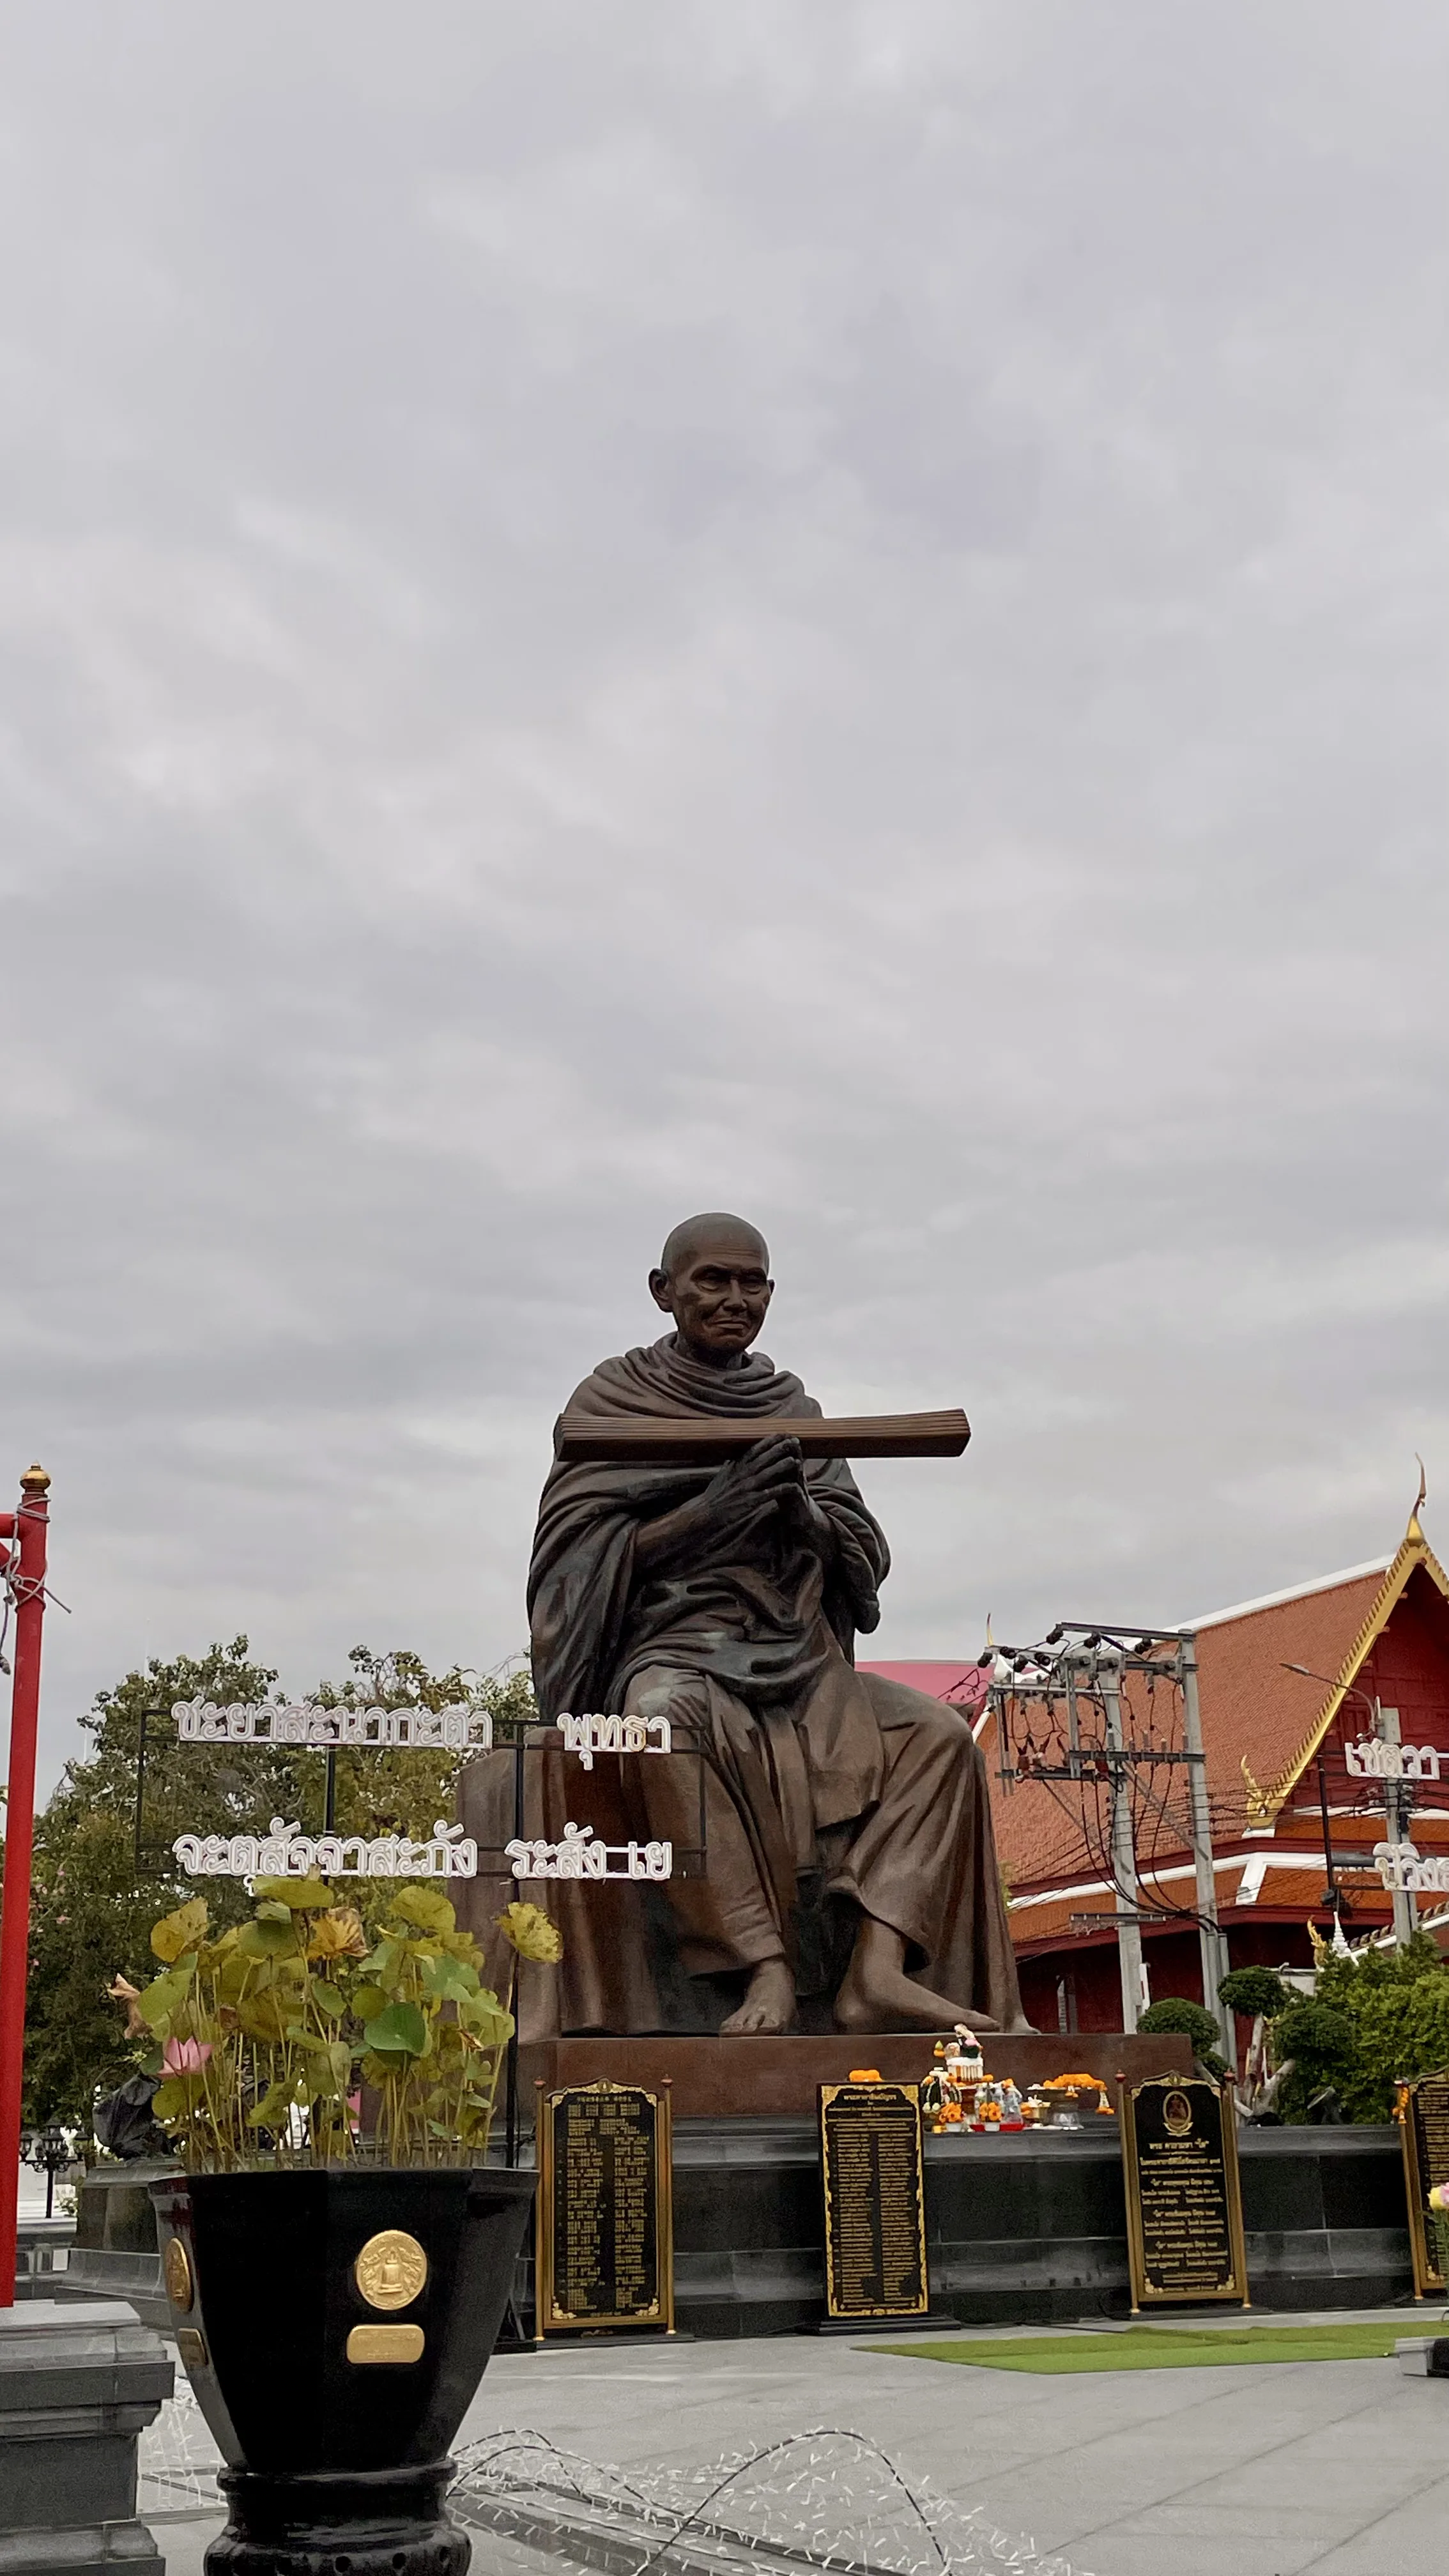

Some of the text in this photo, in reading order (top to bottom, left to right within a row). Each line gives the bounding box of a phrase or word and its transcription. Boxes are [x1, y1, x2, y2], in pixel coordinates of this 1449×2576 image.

[171, 1696, 671, 1770] ชะยาสะนากะตา พุทธา
[1345, 1738, 1440, 1779] เชตวา
[504, 1821, 606, 1879] ระสัง
[628, 1841, 673, 1880] เย
